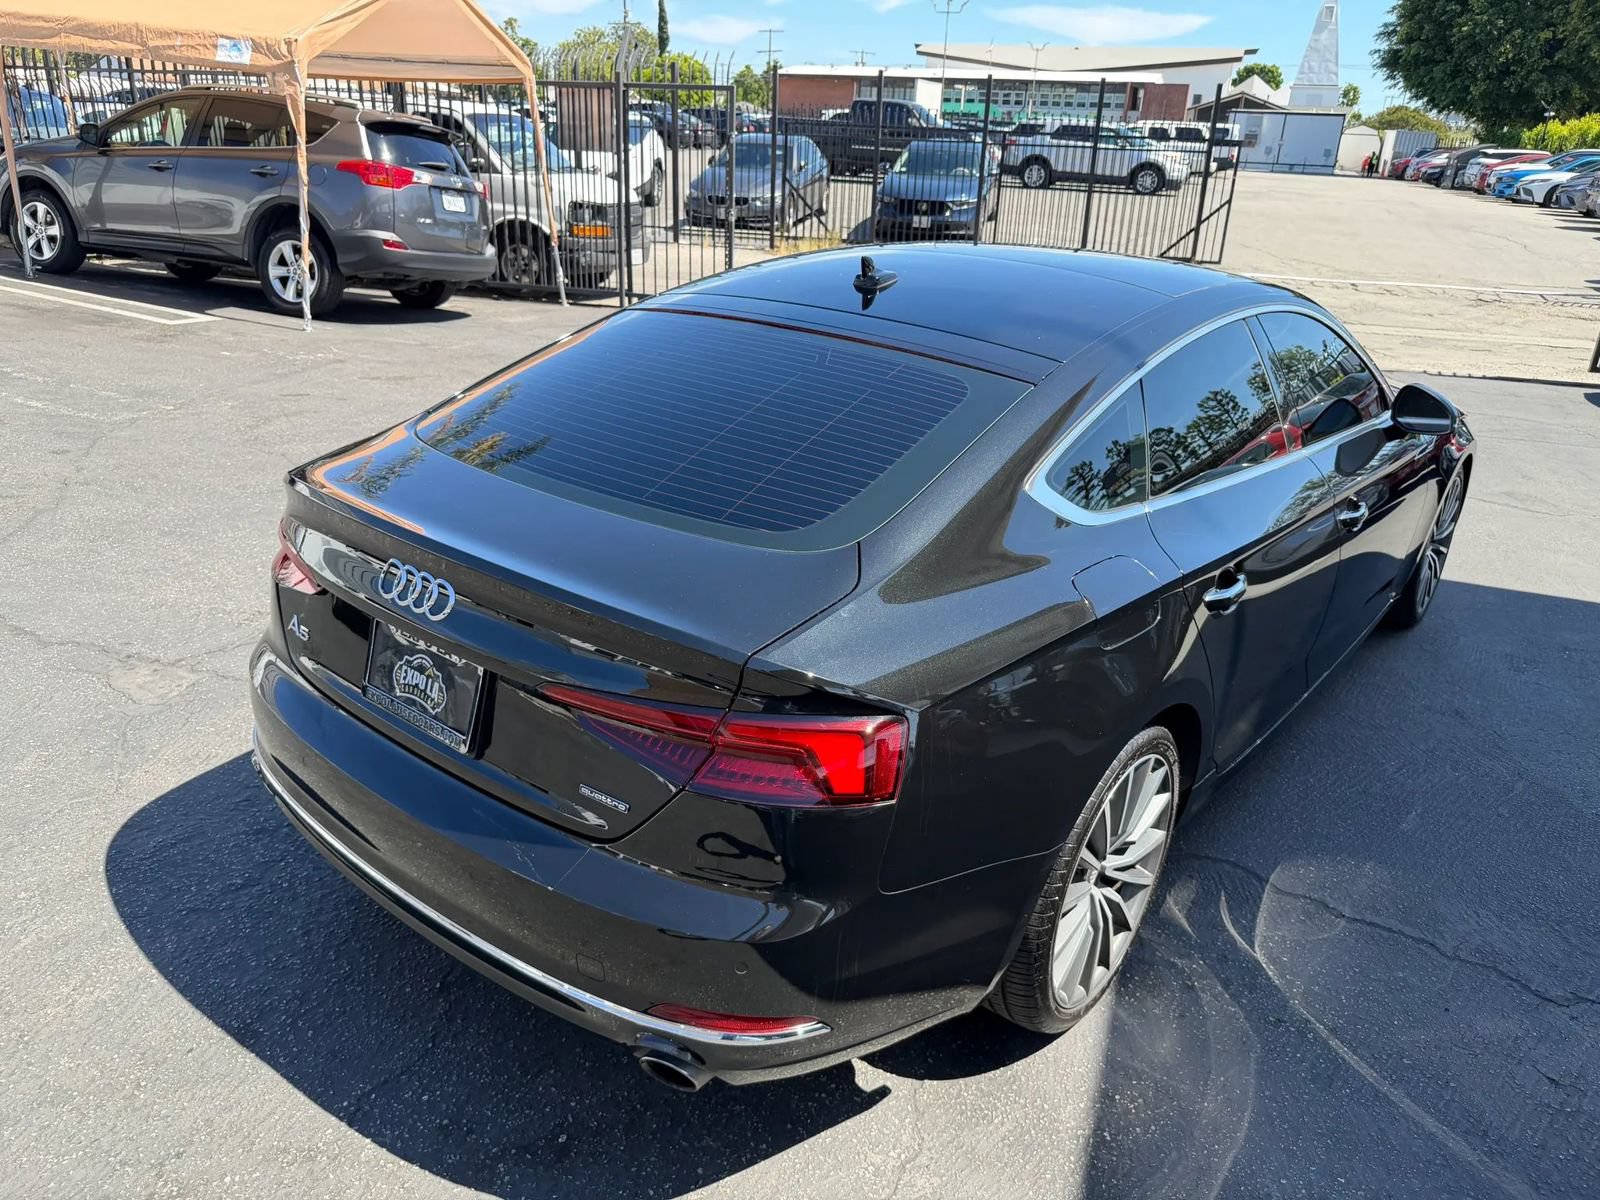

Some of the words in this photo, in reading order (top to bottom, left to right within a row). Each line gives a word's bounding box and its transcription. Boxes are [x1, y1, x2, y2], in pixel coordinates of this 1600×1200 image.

[288, 614, 310, 641] A5
[400, 665, 427, 690] EXPO
[426, 679, 439, 703] LA
[581, 787, 626, 811] quattro
